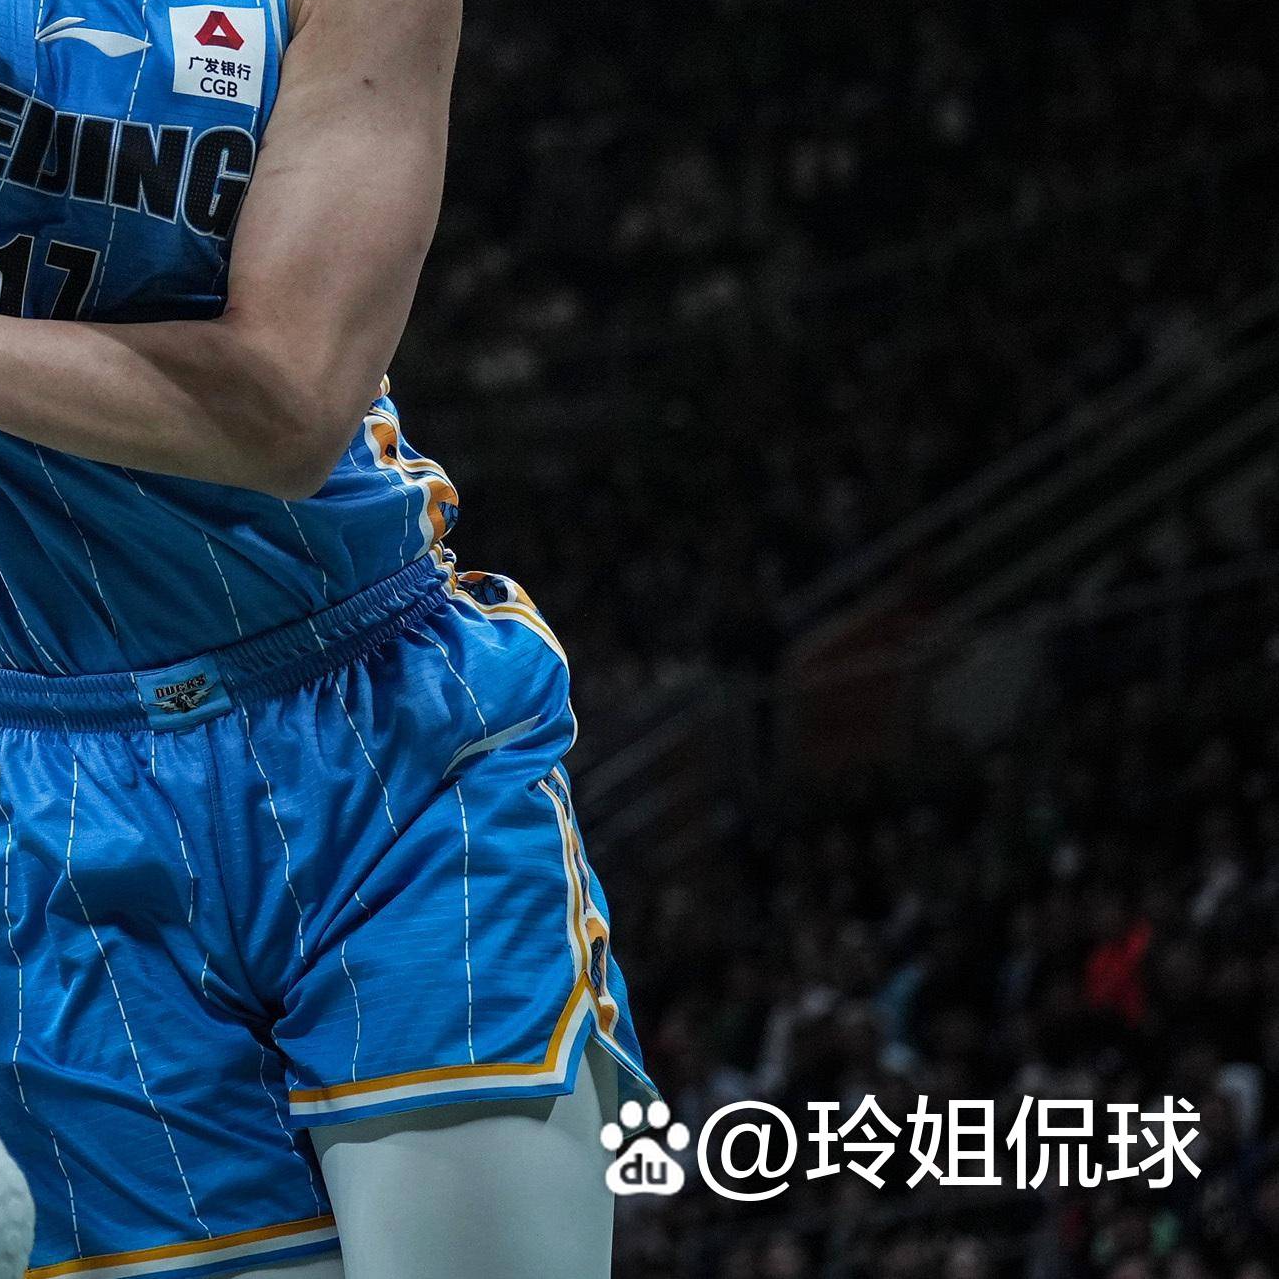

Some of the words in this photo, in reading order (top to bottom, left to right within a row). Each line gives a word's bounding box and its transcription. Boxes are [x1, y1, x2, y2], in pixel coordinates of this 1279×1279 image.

[188, 56, 252, 81] 广发银行
[199, 77, 238, 98] CGB
